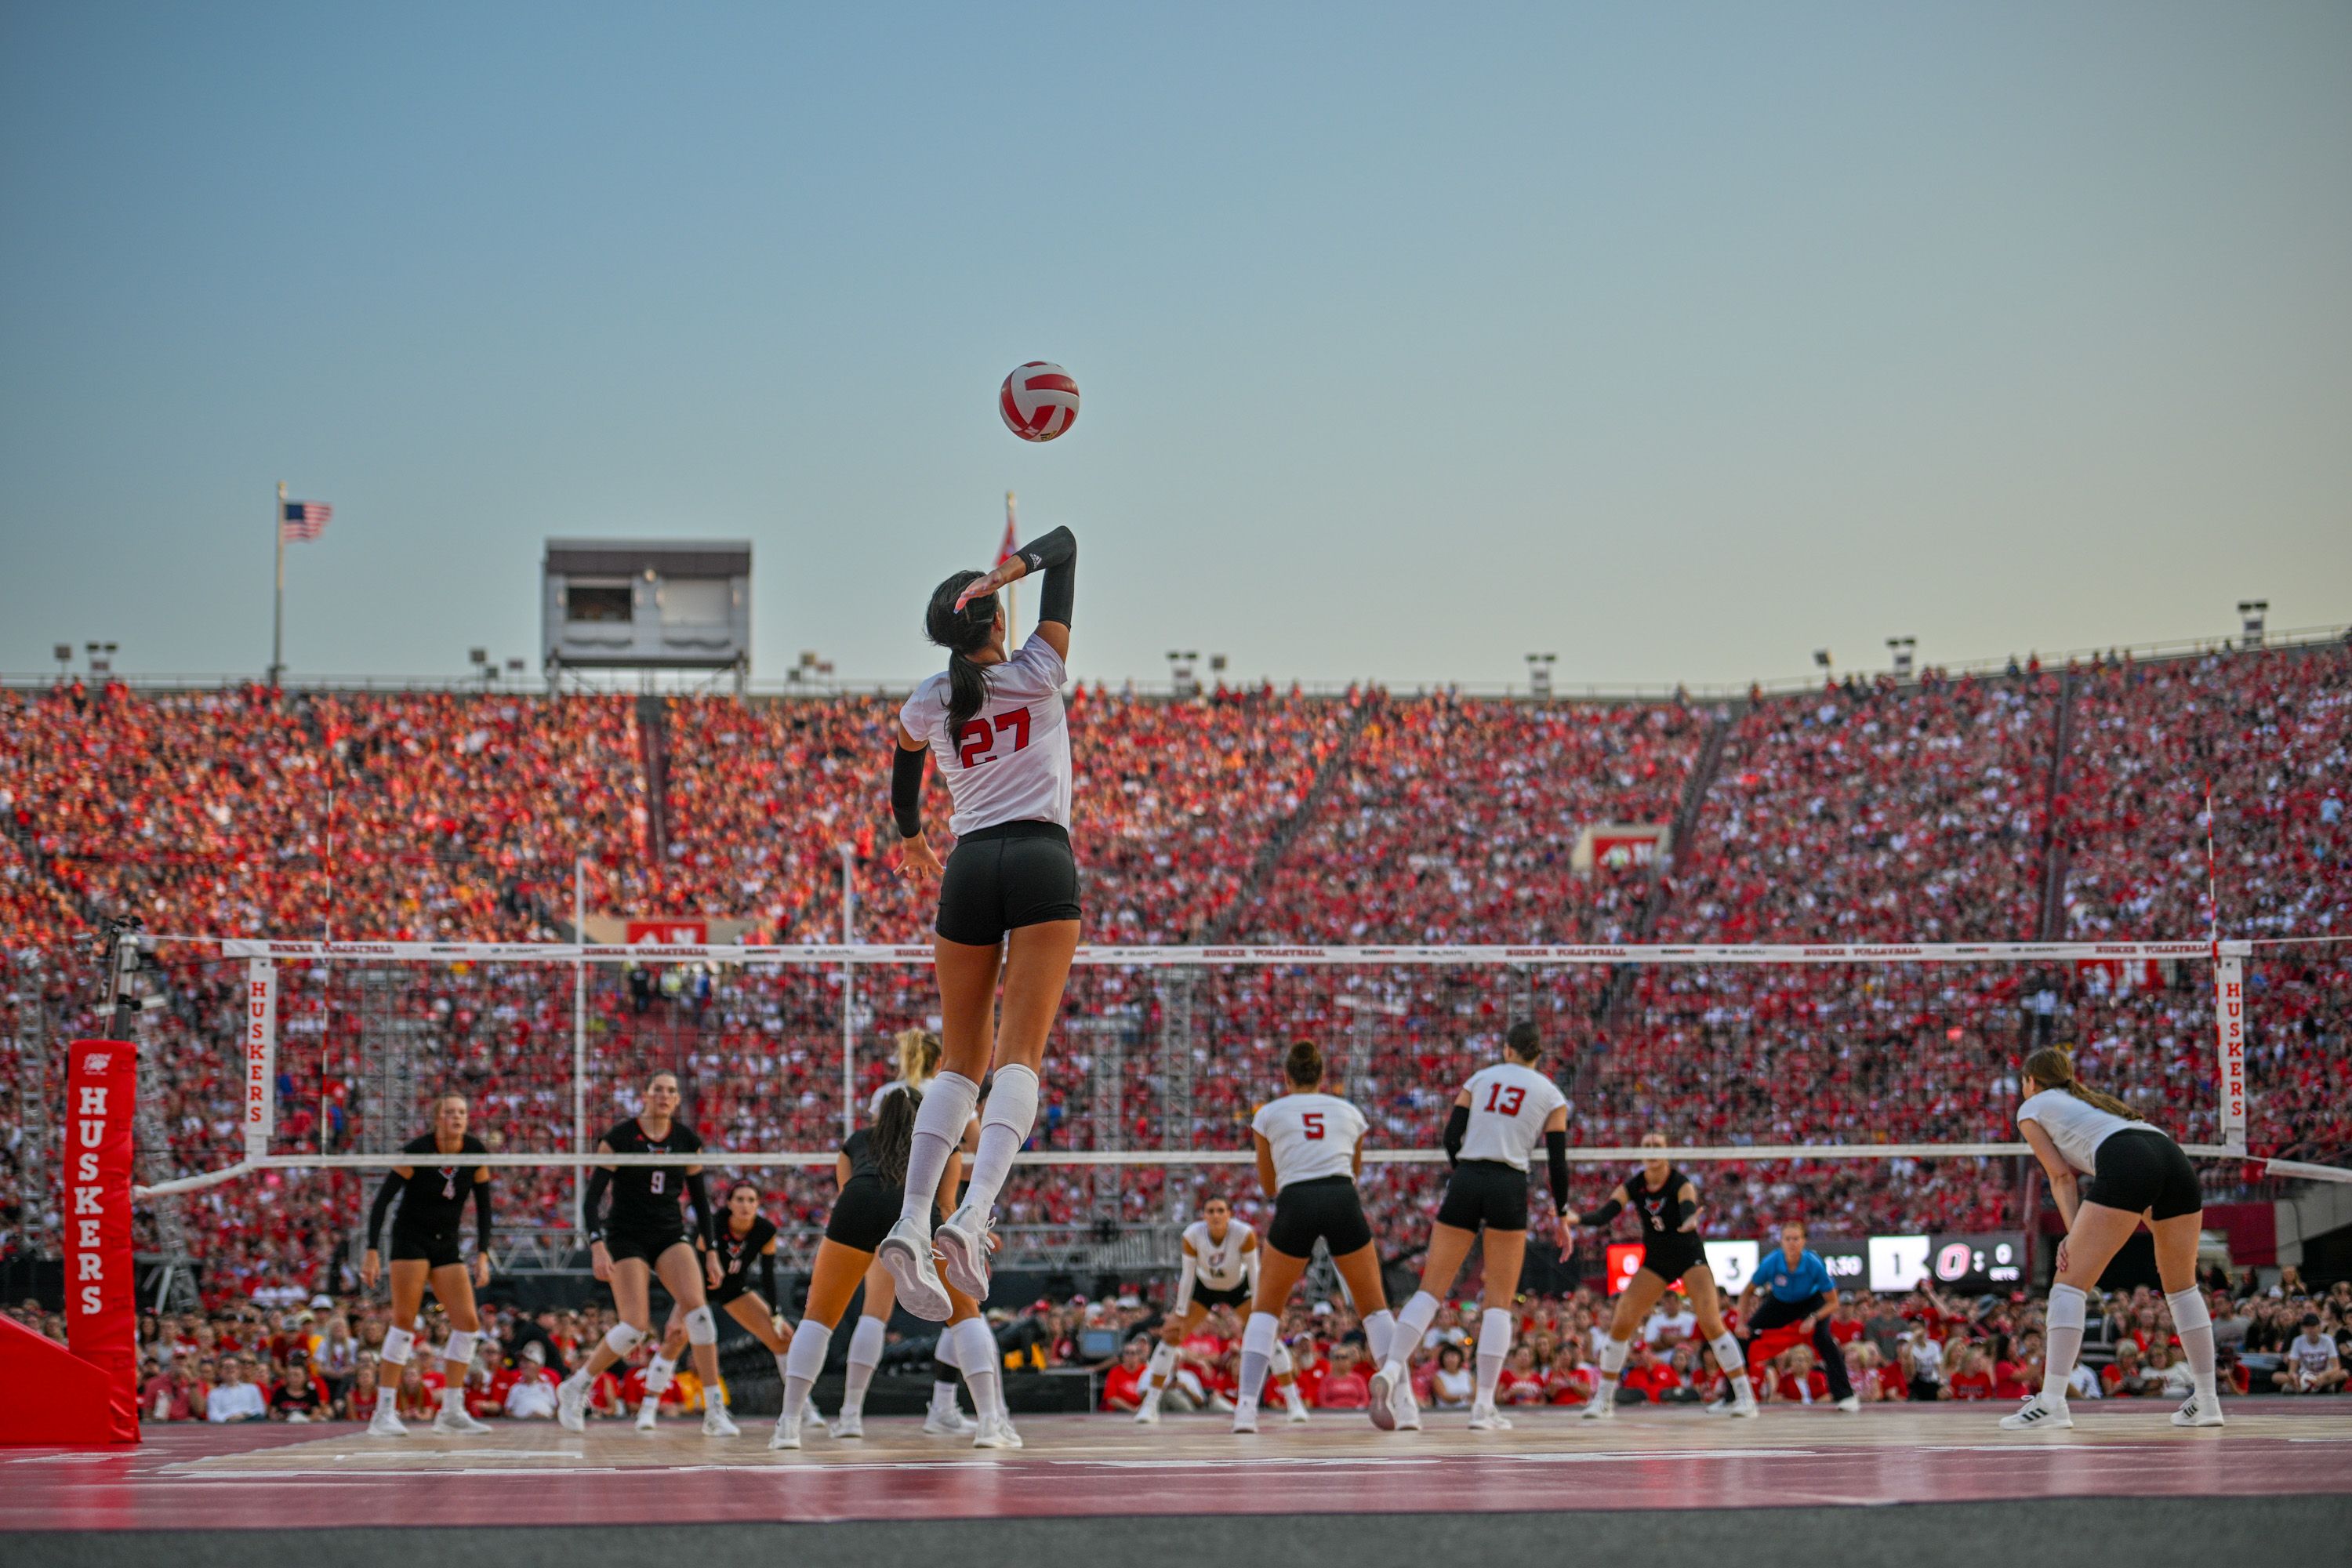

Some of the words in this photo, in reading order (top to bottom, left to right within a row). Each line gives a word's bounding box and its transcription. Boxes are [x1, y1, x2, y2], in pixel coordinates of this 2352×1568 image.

[960, 706, 1032, 769] 27
[249, 982, 267, 1123] HUSKERS
[2225, 982, 2243, 1116] HUSKERS
[1484, 1083, 1526, 1116] 13
[1303, 1113, 1324, 1140] 5
[650, 1171, 666, 1195] 9
[74, 1087, 109, 1316] HUSKERS
[1650, 1215, 1665, 1232] 3
[1894, 1252, 1900, 1276] 1
[1995, 1243, 2013, 1265] 0
[1726, 1257, 1740, 1279] 3
